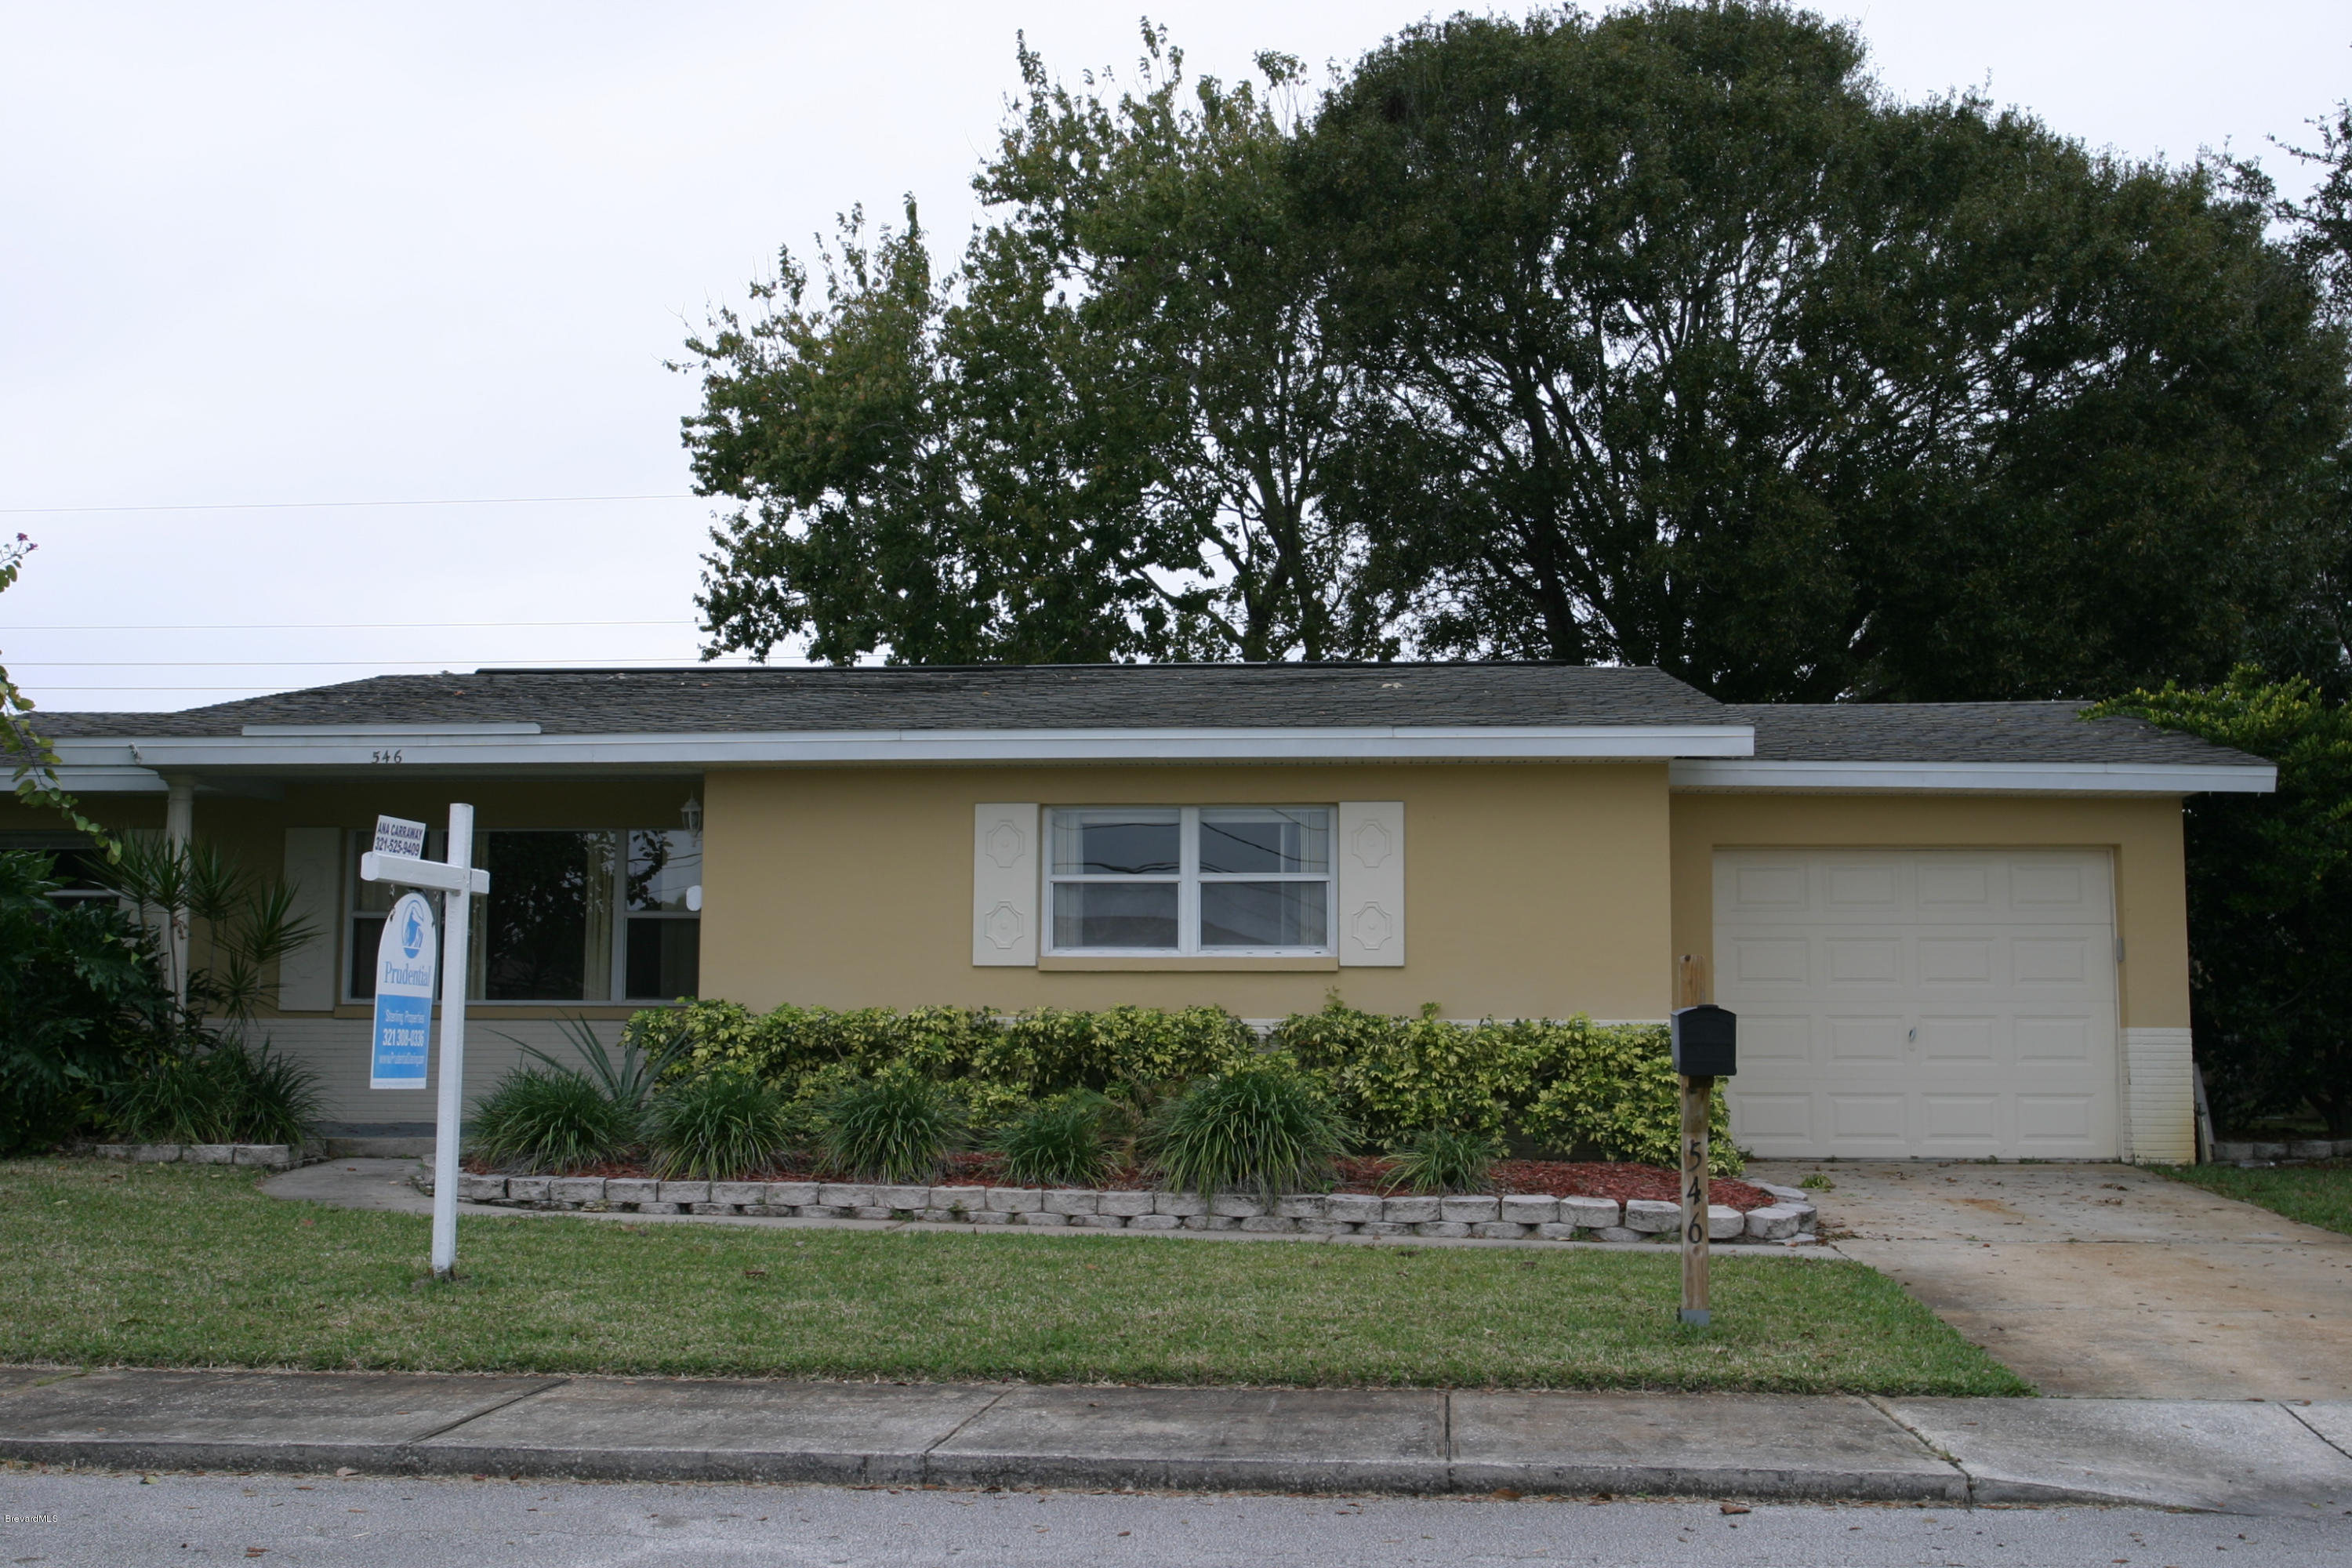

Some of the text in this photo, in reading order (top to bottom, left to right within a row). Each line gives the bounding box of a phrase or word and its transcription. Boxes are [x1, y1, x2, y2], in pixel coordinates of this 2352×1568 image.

[371, 750, 402, 764] 546
[377, 822, 423, 841] ANA CARRAWAY
[375, 837, 420, 857] 321-525-9409
[384, 961, 431, 986] Prudential
[382, 1028, 396, 1046] 321
[1686, 1138, 1703, 1244] 546
